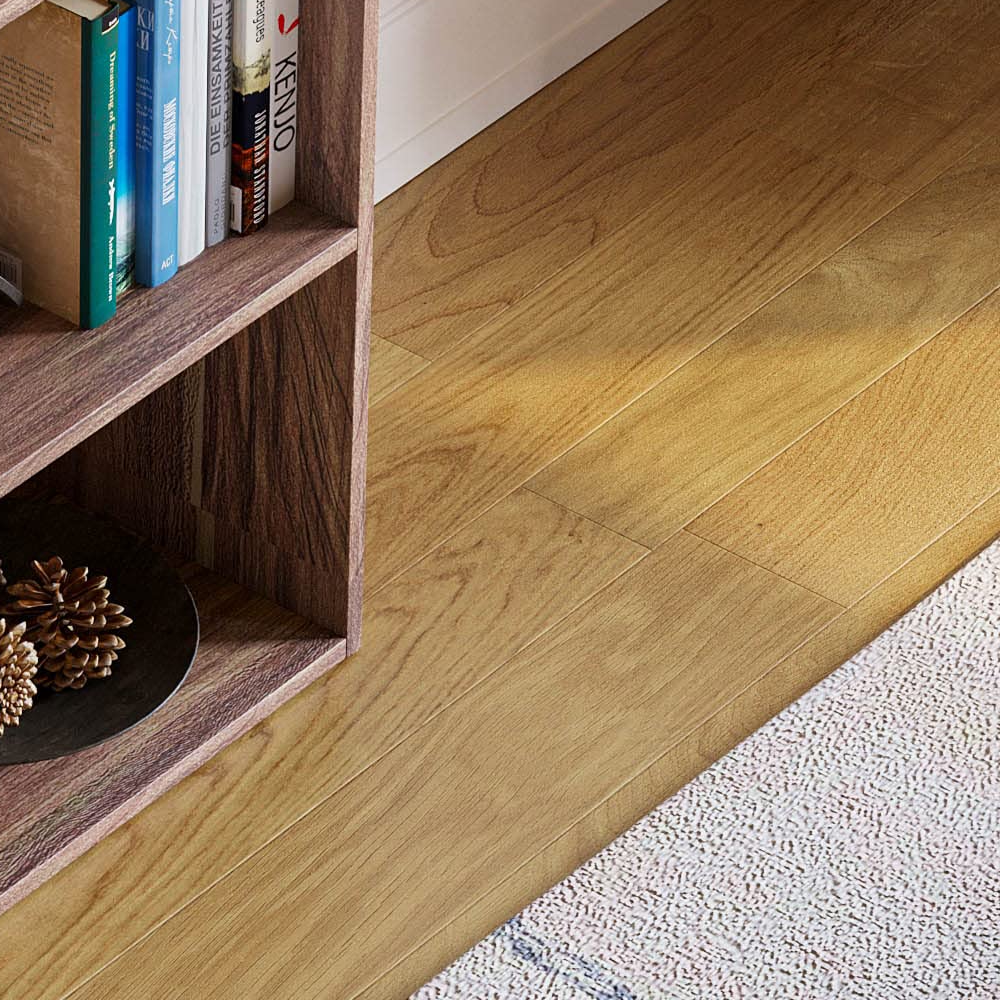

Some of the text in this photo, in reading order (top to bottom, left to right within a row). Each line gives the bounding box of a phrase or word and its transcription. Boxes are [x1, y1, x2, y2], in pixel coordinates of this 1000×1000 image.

[107, 51, 117, 170] Dreaming of Sweden
[210, 2, 223, 156] DIE EINSAMKEIT
[273, 51, 297, 151] KENJO
[253, 109, 267, 224] JONATHAN STANDFORD
